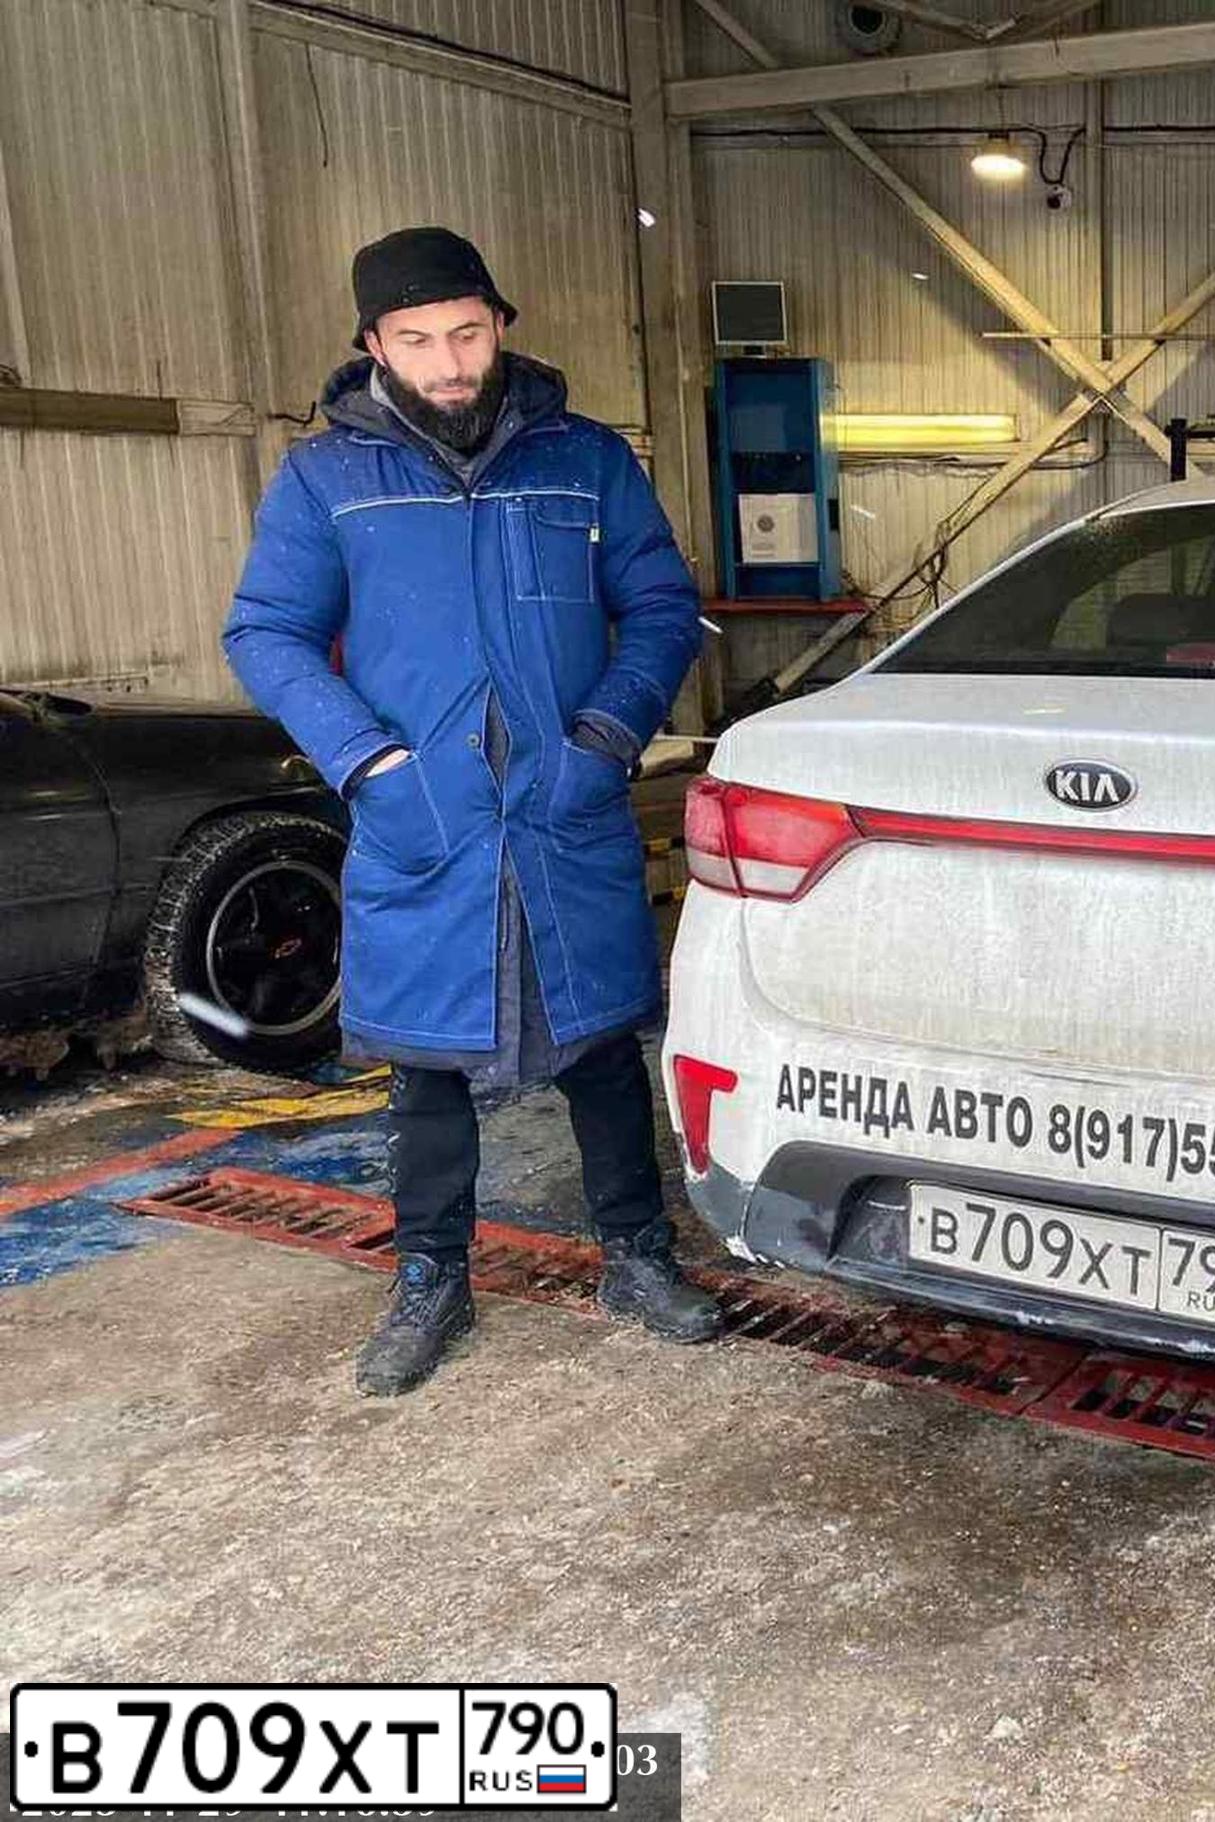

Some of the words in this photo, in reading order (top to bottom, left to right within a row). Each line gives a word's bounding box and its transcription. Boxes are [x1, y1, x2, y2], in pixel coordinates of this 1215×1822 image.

[1055, 770, 1120, 802] KIA
[776, 1063, 915, 1139] АРЕНДА
[926, 1085, 1034, 1148] АВТО
[930, 1202, 1151, 1296] В709ХТ
